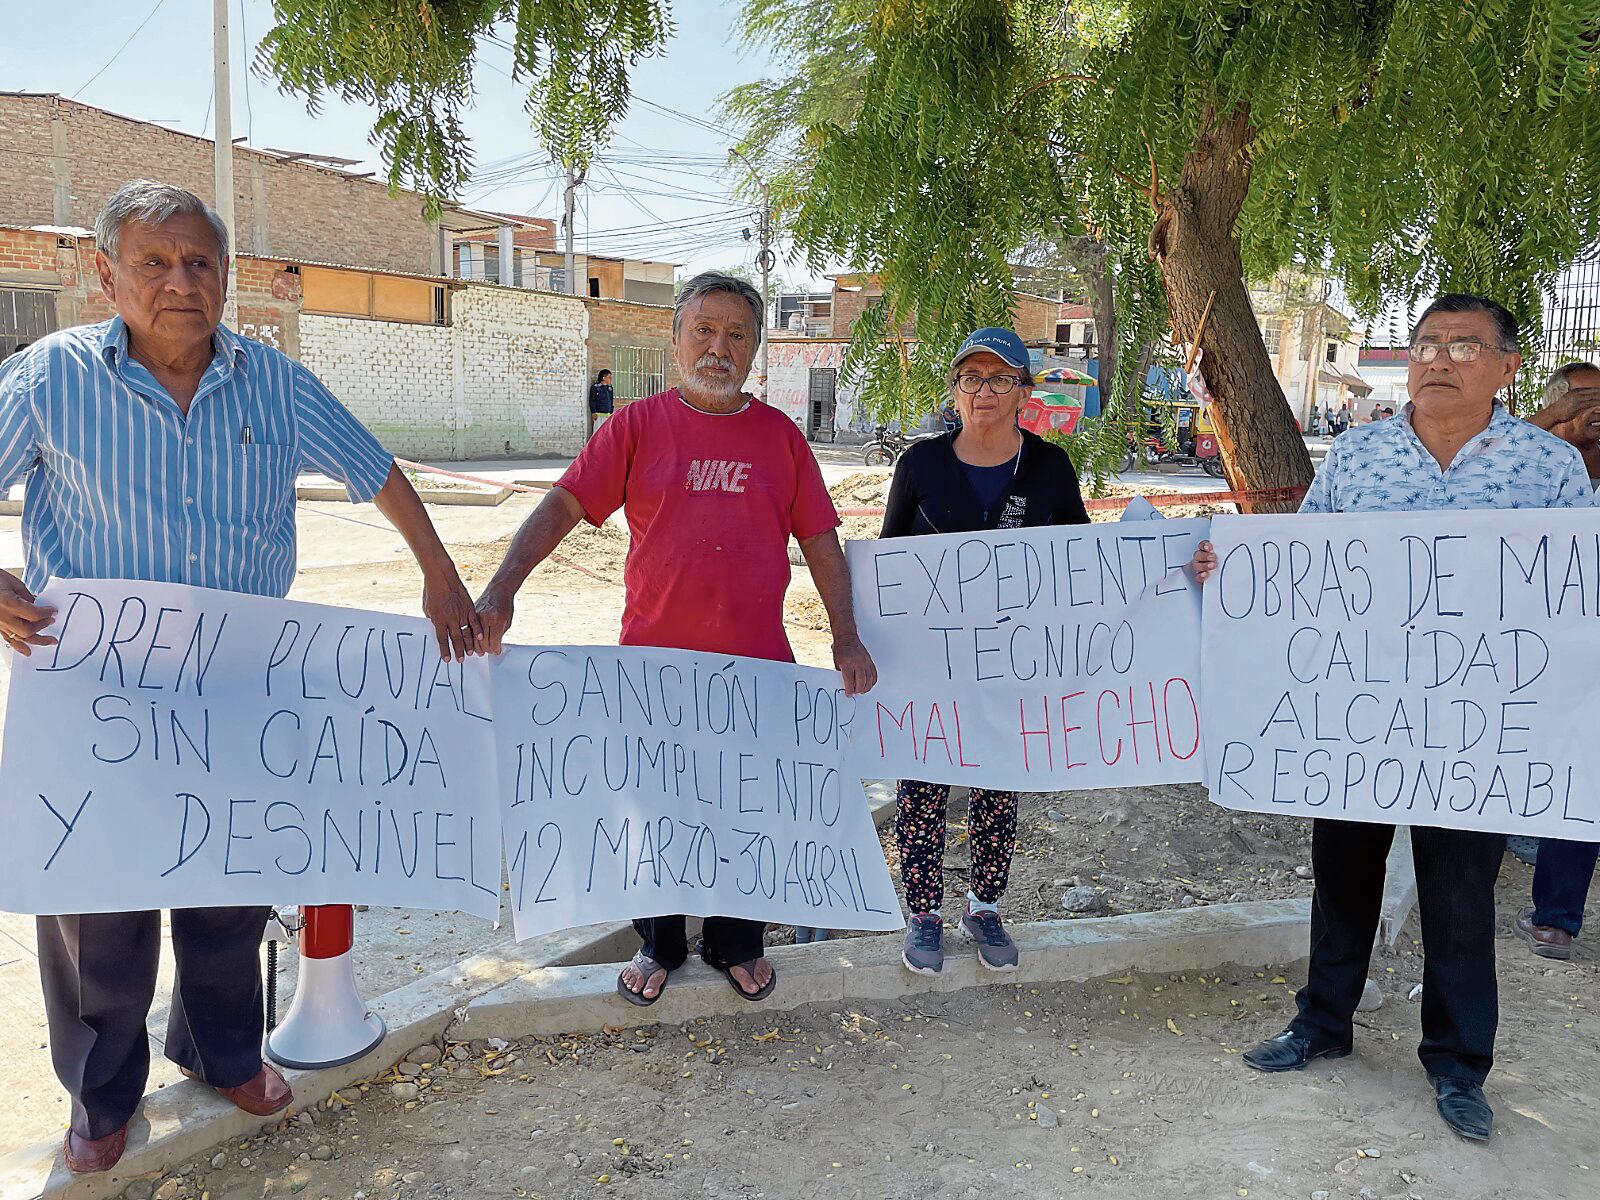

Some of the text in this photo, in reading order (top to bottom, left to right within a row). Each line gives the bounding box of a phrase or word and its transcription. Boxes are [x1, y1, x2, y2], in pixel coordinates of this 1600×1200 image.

[993, 337, 1011, 348] PIURA
[685, 459, 752, 493] NIKE
[874, 532, 1191, 617] EXPEDIENTE
[1219, 539, 1372, 621] OBRAS
[1400, 535, 1467, 627] DE
[36, 592, 492, 722] DREN PLUVIAL
[929, 616, 1134, 681] TÉCNICO
[1288, 624, 1549, 694] CALIDAD
[92, 695, 446, 788] SIN CAÍDA
[528, 650, 857, 751] SANCIÓN POR
[876, 677, 1199, 773] MAL HECHO
[1260, 691, 1538, 754] ALCALDE
[511, 735, 841, 827] INCUMPLIENTO
[1219, 741, 1600, 824] RESPONSABL
[38, 790, 497, 898] Y DESNIVEL
[512, 822, 562, 912] 12
